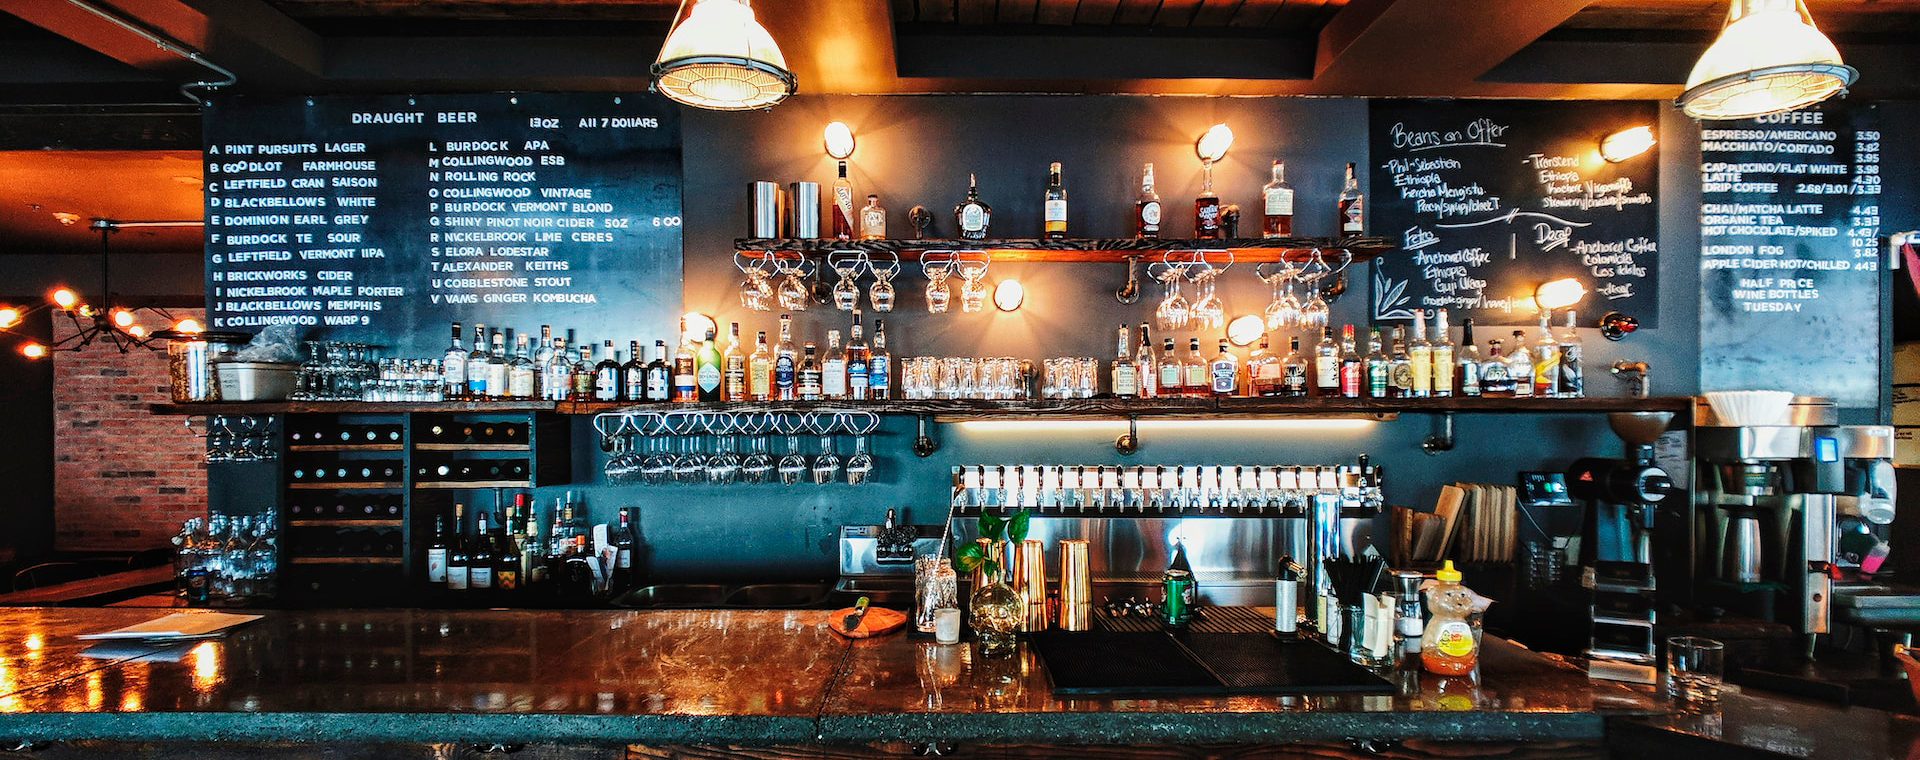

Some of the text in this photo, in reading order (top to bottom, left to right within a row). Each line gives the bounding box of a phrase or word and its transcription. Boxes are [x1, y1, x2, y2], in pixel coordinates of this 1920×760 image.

[352, 112, 477, 124] DRAUGHT BEER
[601, 118, 608, 128] 7
[1755, 112, 1823, 125] COFFEE
[1390, 118, 1509, 149] Beans on Offer
[1702, 130, 1880, 141] ESPRESSO/AMERICANO 3.50
[209, 143, 366, 155] A PINT PURSUITS LAGER
[429, 140, 549, 151] L BURDOCK APA
[1702, 141, 1879, 154] MACCHIATO/CORTADO 3.82
[429, 156, 565, 168] M COLLINGWOOD ESB
[1856, 154, 1879, 163] 3.95
[210, 160, 376, 173] B GOODLOT FARMHOUSE
[1810, 164, 1847, 174] WHITE
[1856, 165, 1879, 174] 3.98
[429, 172, 536, 182] N ROLLING ROCK
[1702, 173, 1741, 183] LATTE
[209, 177, 377, 192] C LEFTFIELD CRAN SAISON
[1702, 183, 1731, 193] DRIP
[1733, 183, 1778, 193] COFFEE
[443, 187, 531, 198] COLLINGWOOD
[540, 188, 592, 198] VINTAGE
[211, 197, 376, 208] D BLACKBELLOWS WHITE
[430, 202, 613, 213] P BURDOCK VERMONT BLOND
[1702, 204, 1878, 215] CHAI/MATCHA LATTE 4.43
[211, 215, 369, 226] E DOMINION EARL GREY
[429, 216, 440, 227] Q
[444, 217, 482, 227] SHINY
[487, 217, 521, 227] PINOT
[523, 218, 553, 227] NOIR
[557, 218, 594, 228] CIDER
[1702, 216, 1879, 226] ORGANIC TEA 3.33
[1703, 226, 1728, 235] HOT
[1730, 226, 1837, 236] CHOCOLATE/SPIKED
[211, 233, 360, 245] F BURDOCK TE SOUR
[430, 232, 613, 242] R NICKELBROOK LIME CERES
[212, 254, 222, 263] G
[228, 251, 291, 263] LEFTFIELD
[299, 249, 355, 260] VERMONT
[431, 247, 549, 257] S ELORA LODESTAR
[1702, 246, 1878, 258] LONDON FOG 3.82
[431, 261, 569, 272] T ALEXANDER KEITHS
[1702, 258, 1739, 269] APPLE
[1742, 258, 1778, 269] CIDER
[1780, 259, 1850, 270] HOT/CHILLED
[213, 271, 353, 281] H BRICKWORKS CIDER
[432, 277, 571, 288] U COBBLESTONE STOUT
[1740, 278, 1813, 288] HALF PRICE
[227, 286, 306, 297] NICKELBROOK
[313, 286, 352, 296] MAPLE
[358, 287, 403, 297] PORTER
[1733, 289, 1818, 299] WINE BOTTLES
[431, 294, 596, 304] V VAMS GINGER KOMBUCHA
[215, 301, 381, 312] J BLACKBELLOWS MEMPHIS
[1744, 302, 1801, 313] TUESDAY
[214, 316, 369, 327] K COLLINGWOOD WARP 9
